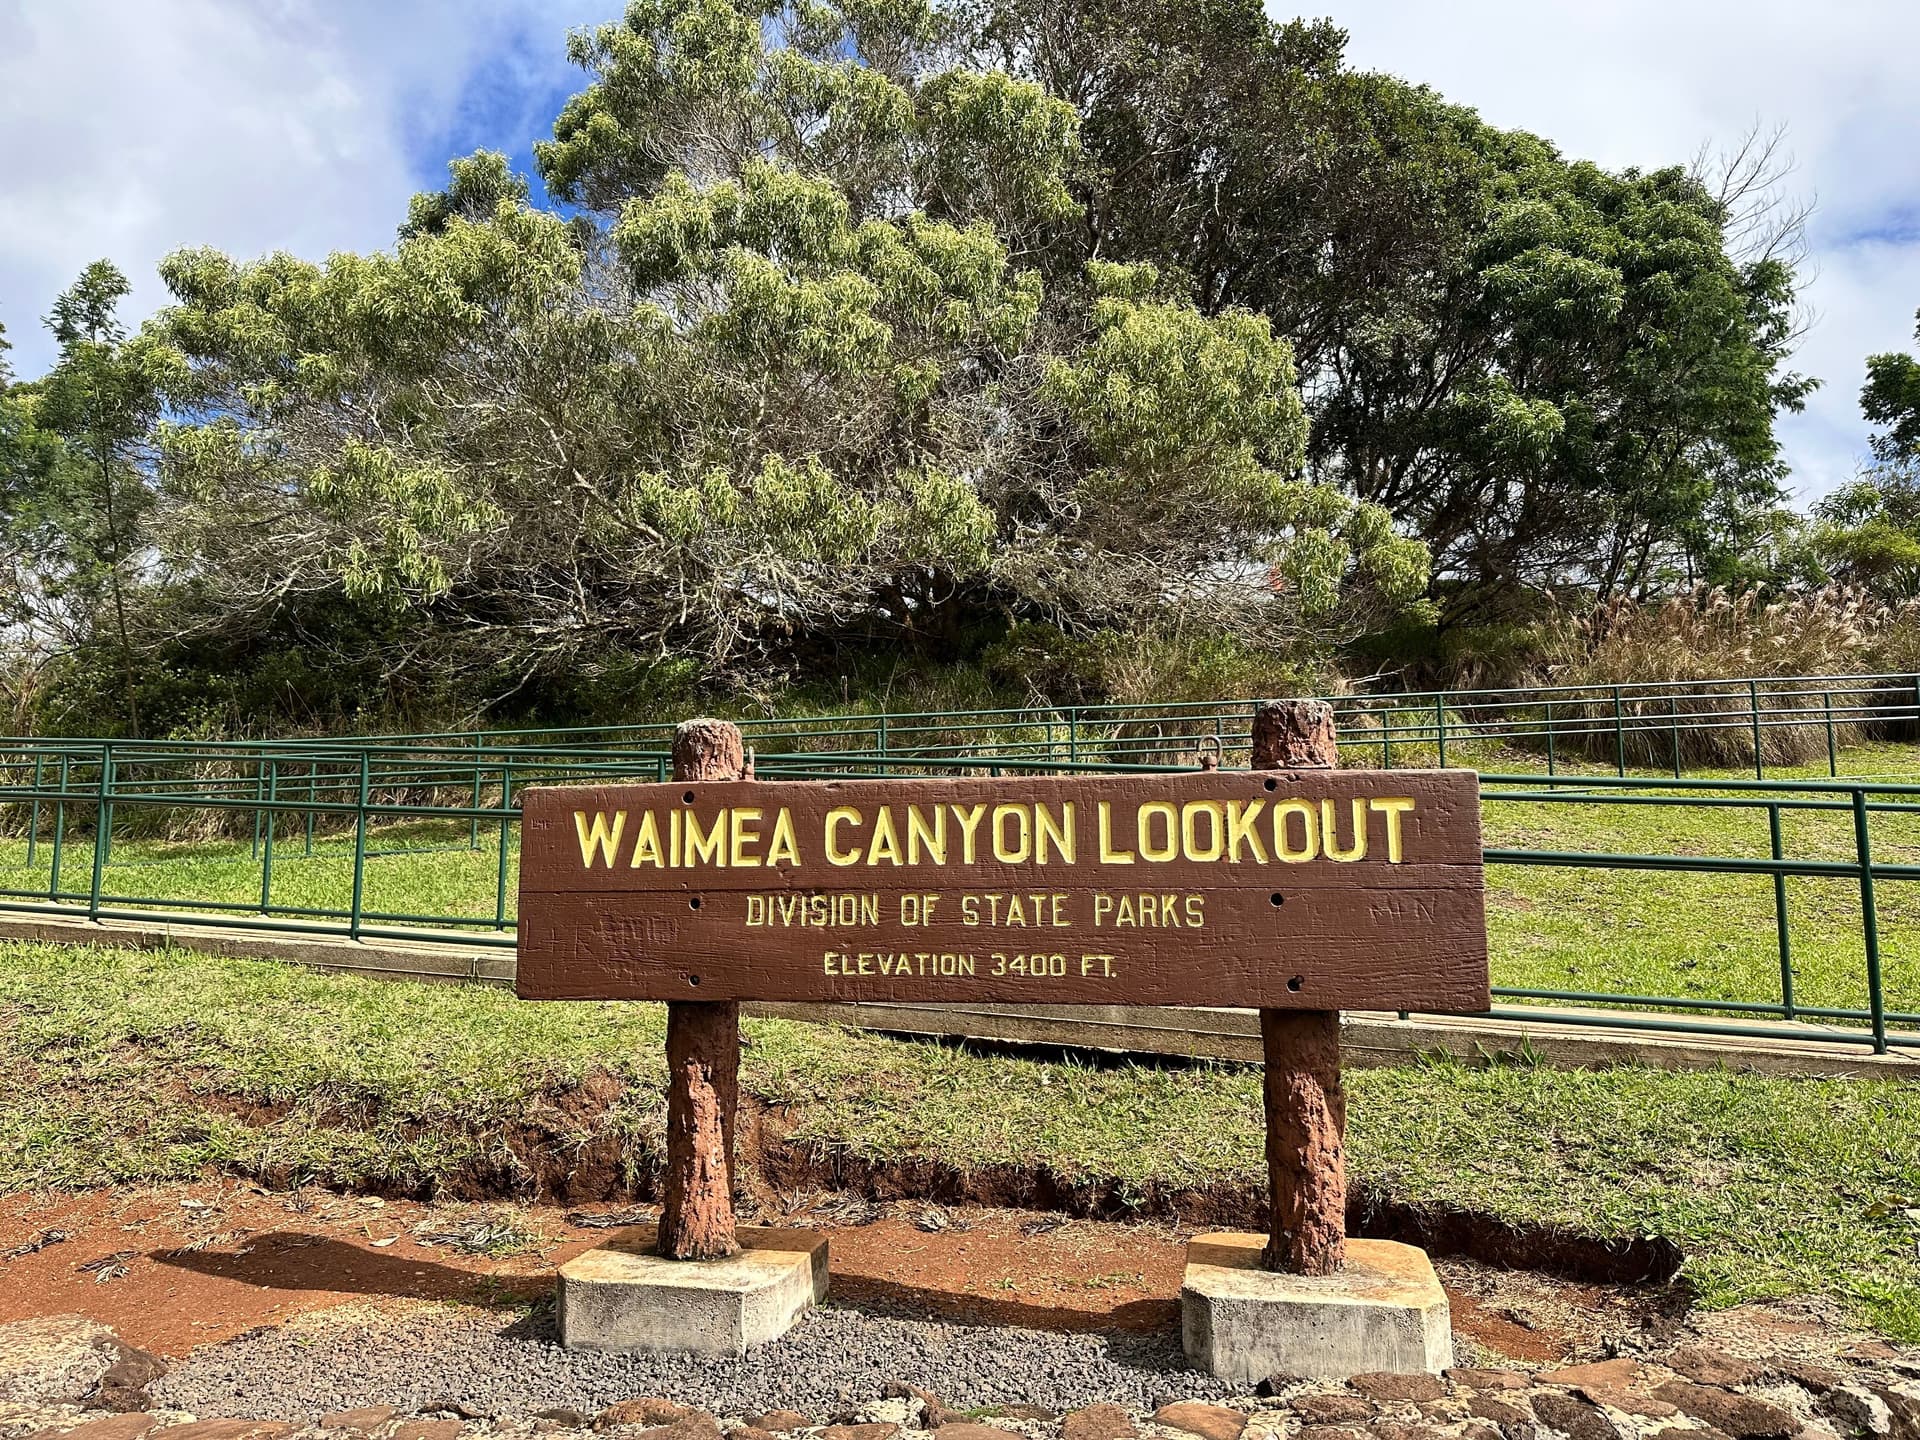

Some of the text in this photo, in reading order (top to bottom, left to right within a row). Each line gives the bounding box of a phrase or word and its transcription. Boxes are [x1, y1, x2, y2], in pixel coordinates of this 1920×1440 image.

[573, 796, 1416, 869] WAIMEA CANYON LOOKOUT
[745, 893, 1205, 929] DIVISION OF STATE PARKS
[823, 951, 1117, 978] ELEVATION 3400 FT.
